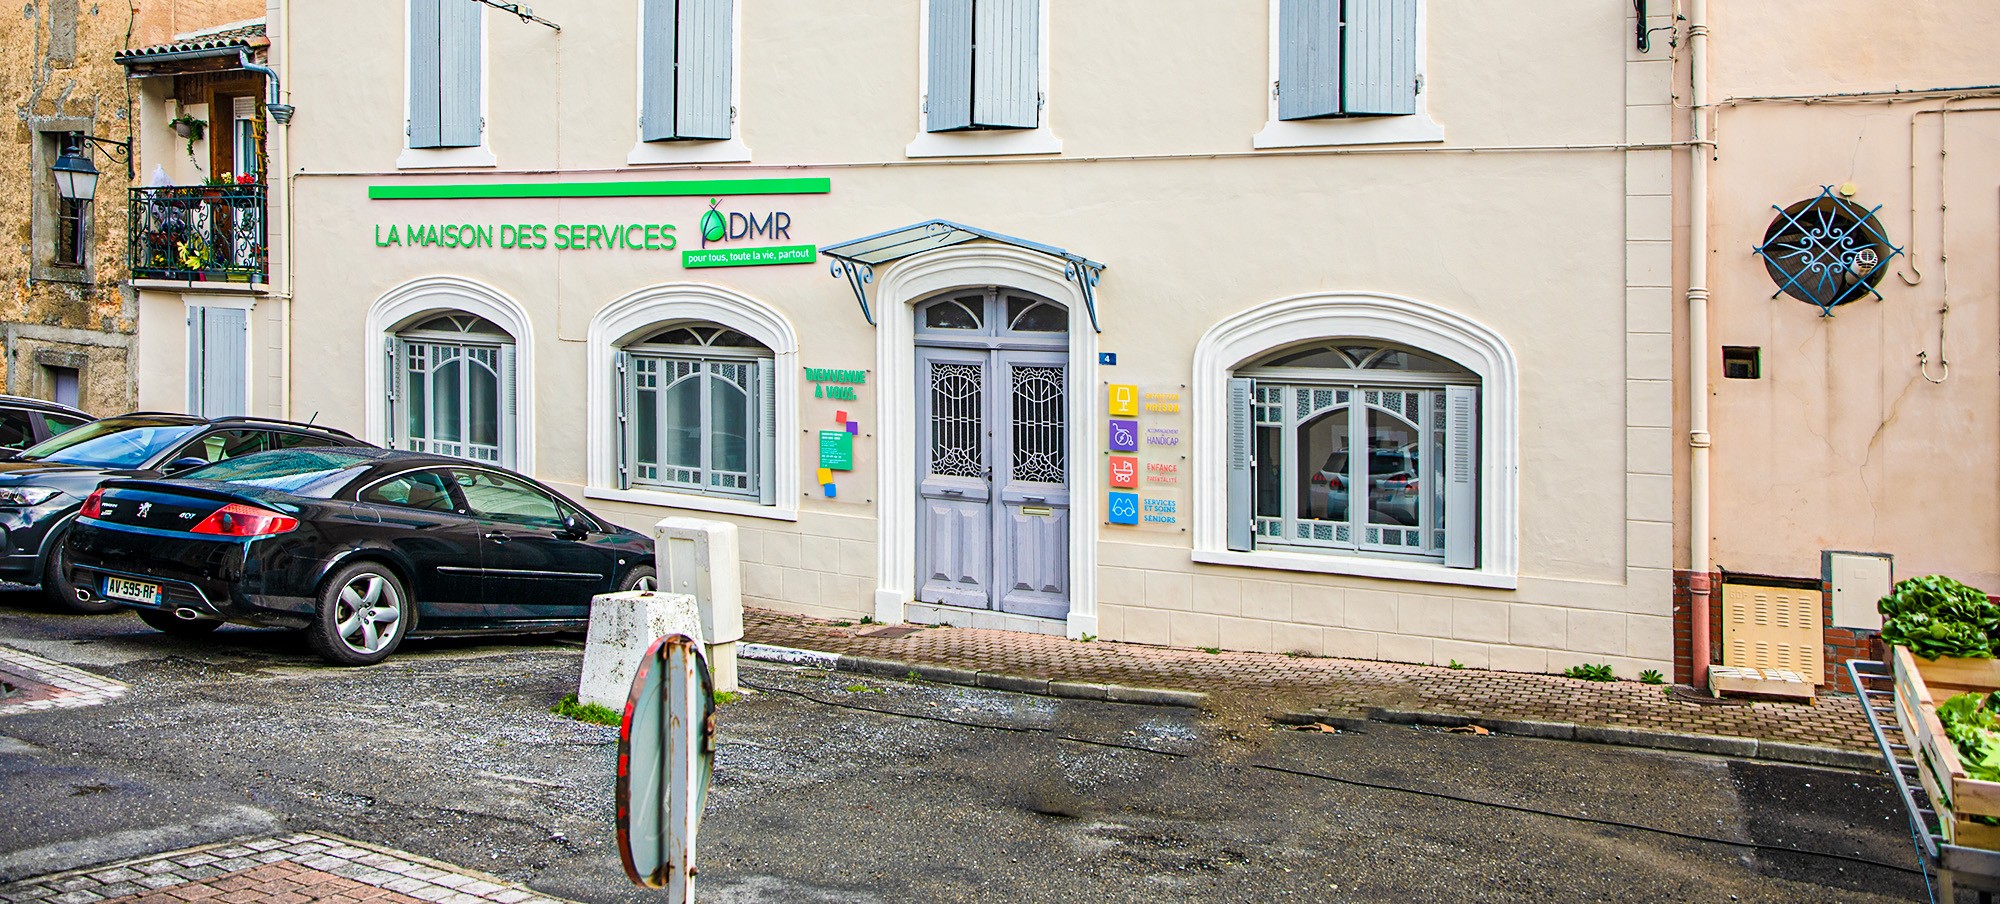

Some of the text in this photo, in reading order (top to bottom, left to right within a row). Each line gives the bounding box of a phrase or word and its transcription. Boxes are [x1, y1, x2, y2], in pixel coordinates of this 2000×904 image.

[701, 199, 791, 249] ADMR
[375, 224, 677, 251] LA MAISON DES SERVICES
[688, 248, 810, 264] pour tous, toute la vie, partout
[805, 367, 866, 384] BIENVENUE
[814, 382, 857, 401] À VOUS.
[1146, 436, 1179, 446] HANDICAP
[1146, 462, 1177, 472] ENFANCE
[1143, 499, 1176, 507] SERVICES
[1154, 505, 1176, 513] SOINS
[109, 579, 155, 598] AV-595-RF
